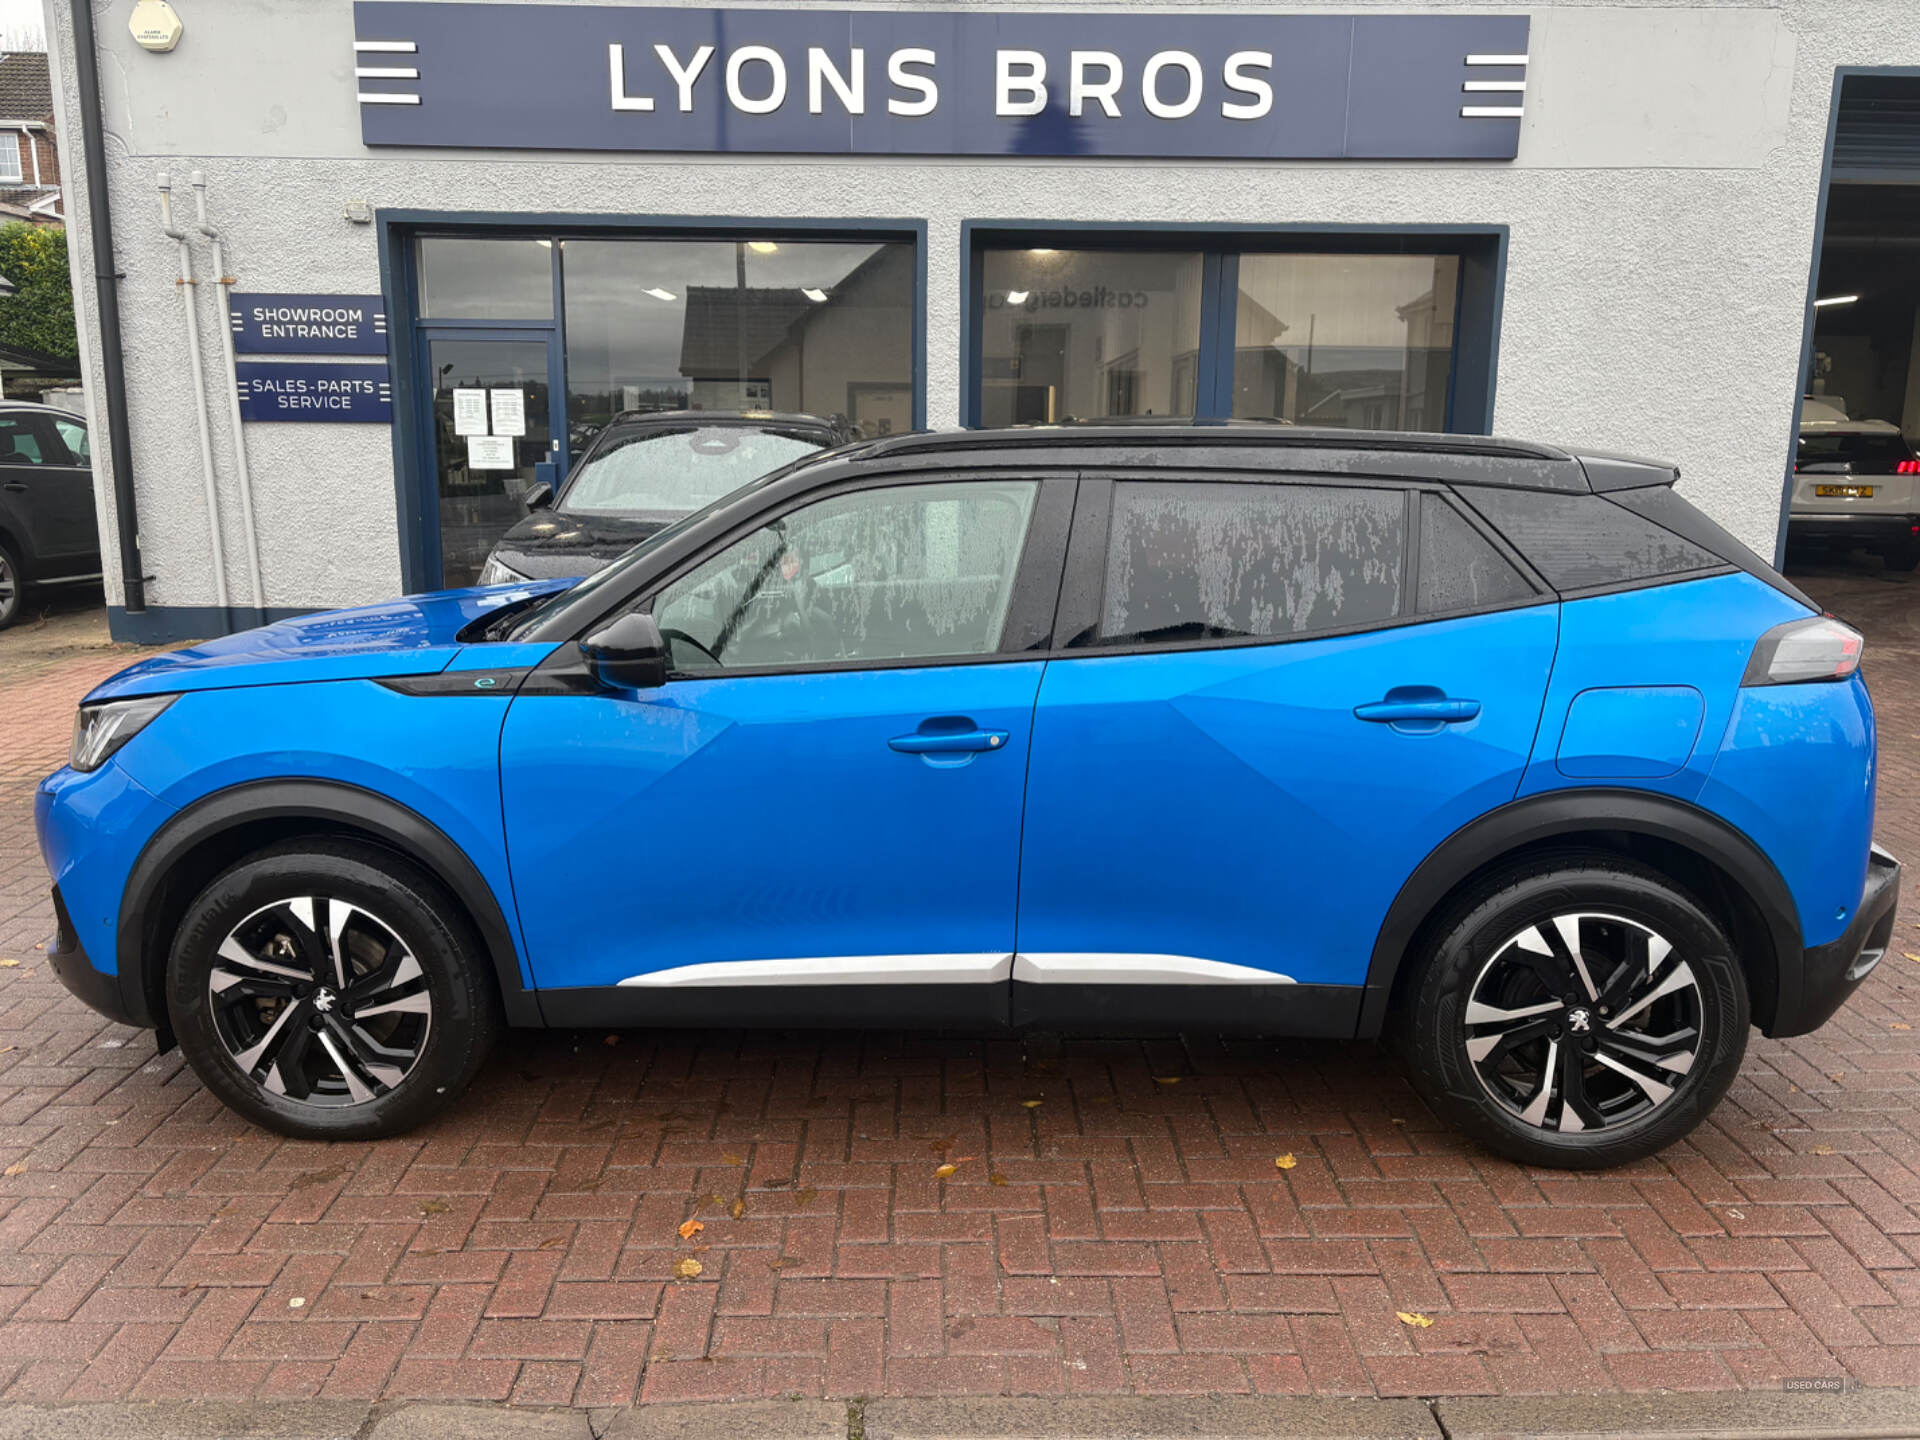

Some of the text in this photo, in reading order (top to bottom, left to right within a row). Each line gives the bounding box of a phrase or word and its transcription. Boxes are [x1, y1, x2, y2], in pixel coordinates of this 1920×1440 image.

[608, 43, 1275, 120] LYONS BROS
[253, 307, 363, 323] SHOWROOM
[261, 324, 358, 339] ENTRANCE
[277, 396, 352, 409] SERVICE
